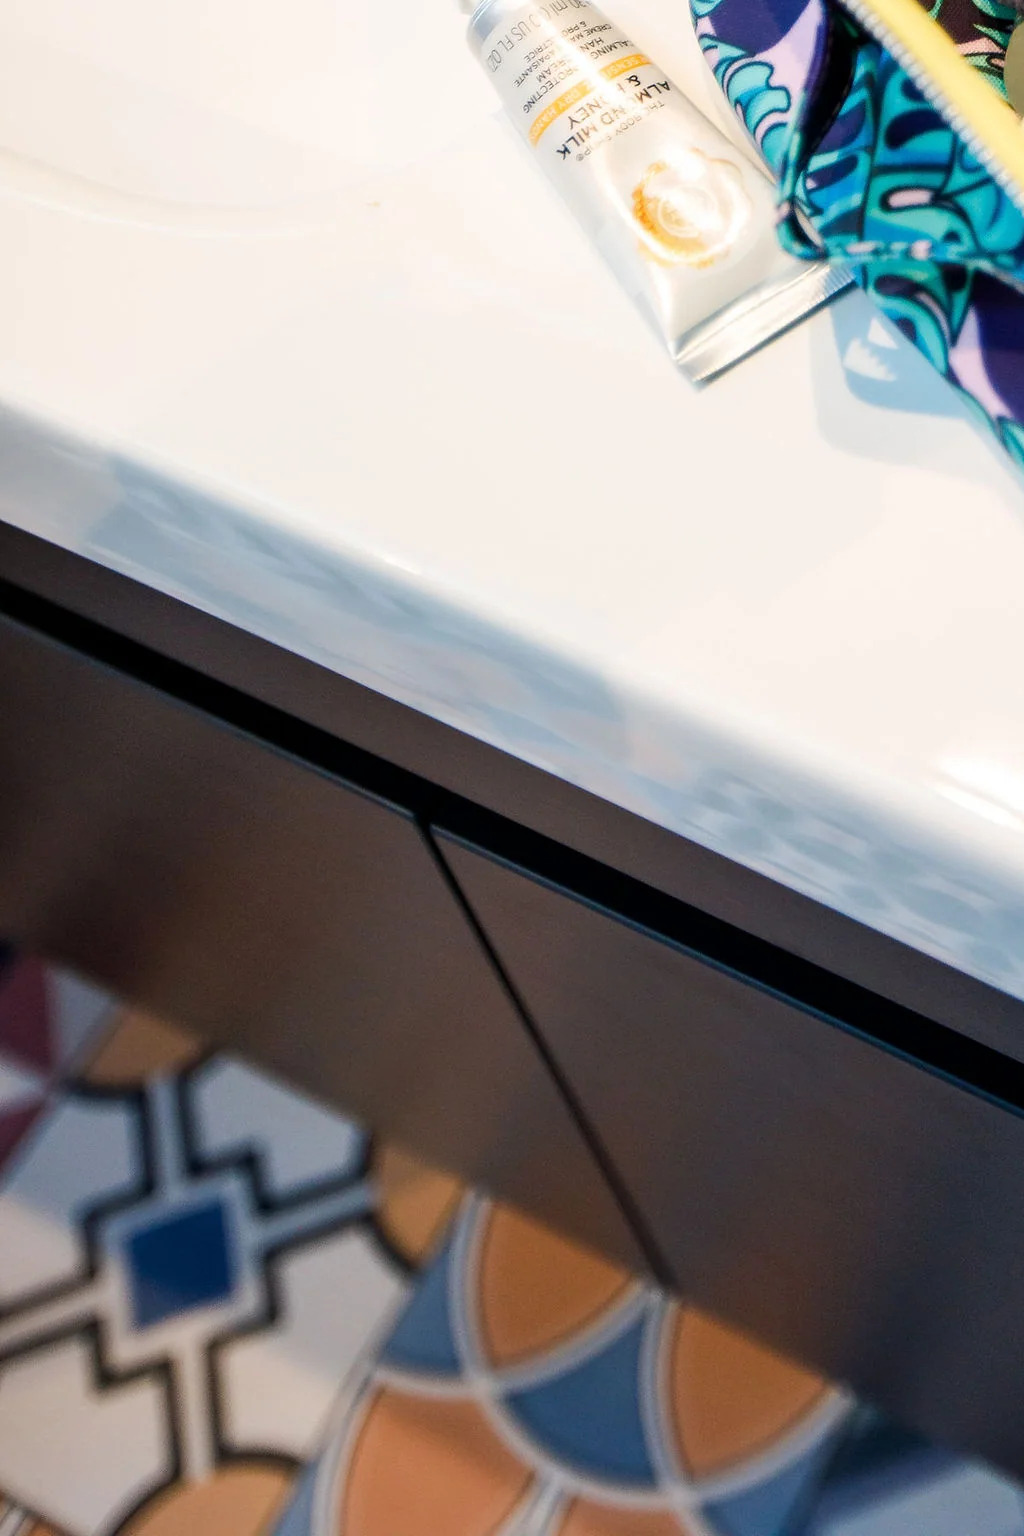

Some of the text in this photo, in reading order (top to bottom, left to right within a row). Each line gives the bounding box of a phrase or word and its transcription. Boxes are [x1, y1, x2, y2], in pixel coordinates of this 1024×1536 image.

[496, 35, 514, 55] FL
[508, 20, 530, 41] US
[522, 22, 579, 63] PROCTRICE
[575, 35, 604, 55] HAN
[513, 48, 554, 87] APAISANTE
[565, 74, 639, 130] & HNEY
[555, 121, 598, 160] MILK
